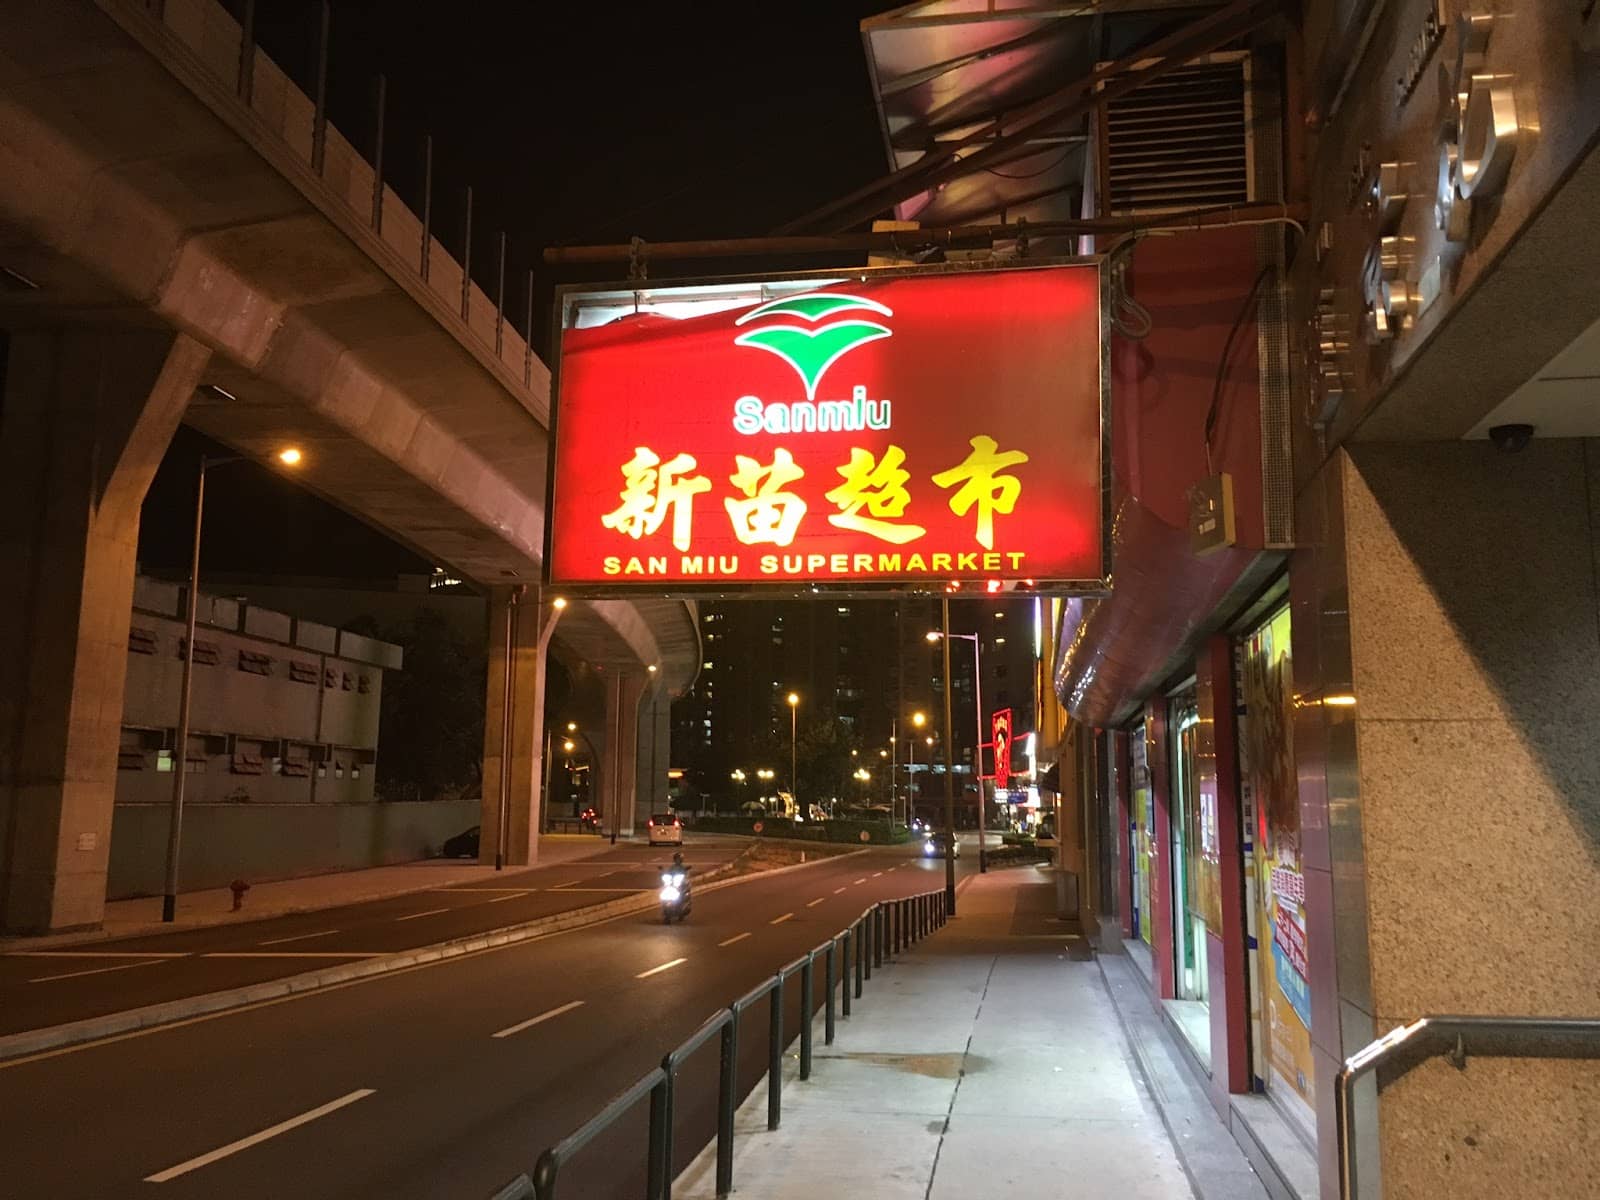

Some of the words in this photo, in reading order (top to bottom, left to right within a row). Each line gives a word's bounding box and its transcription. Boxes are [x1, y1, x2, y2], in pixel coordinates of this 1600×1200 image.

[733, 385, 891, 434] Sanmiu
[601, 435, 1029, 552] 新苗超市
[603, 556, 667, 575] SAN
[681, 555, 739, 574] MIU
[760, 552, 1025, 573] SUPERMARKET
